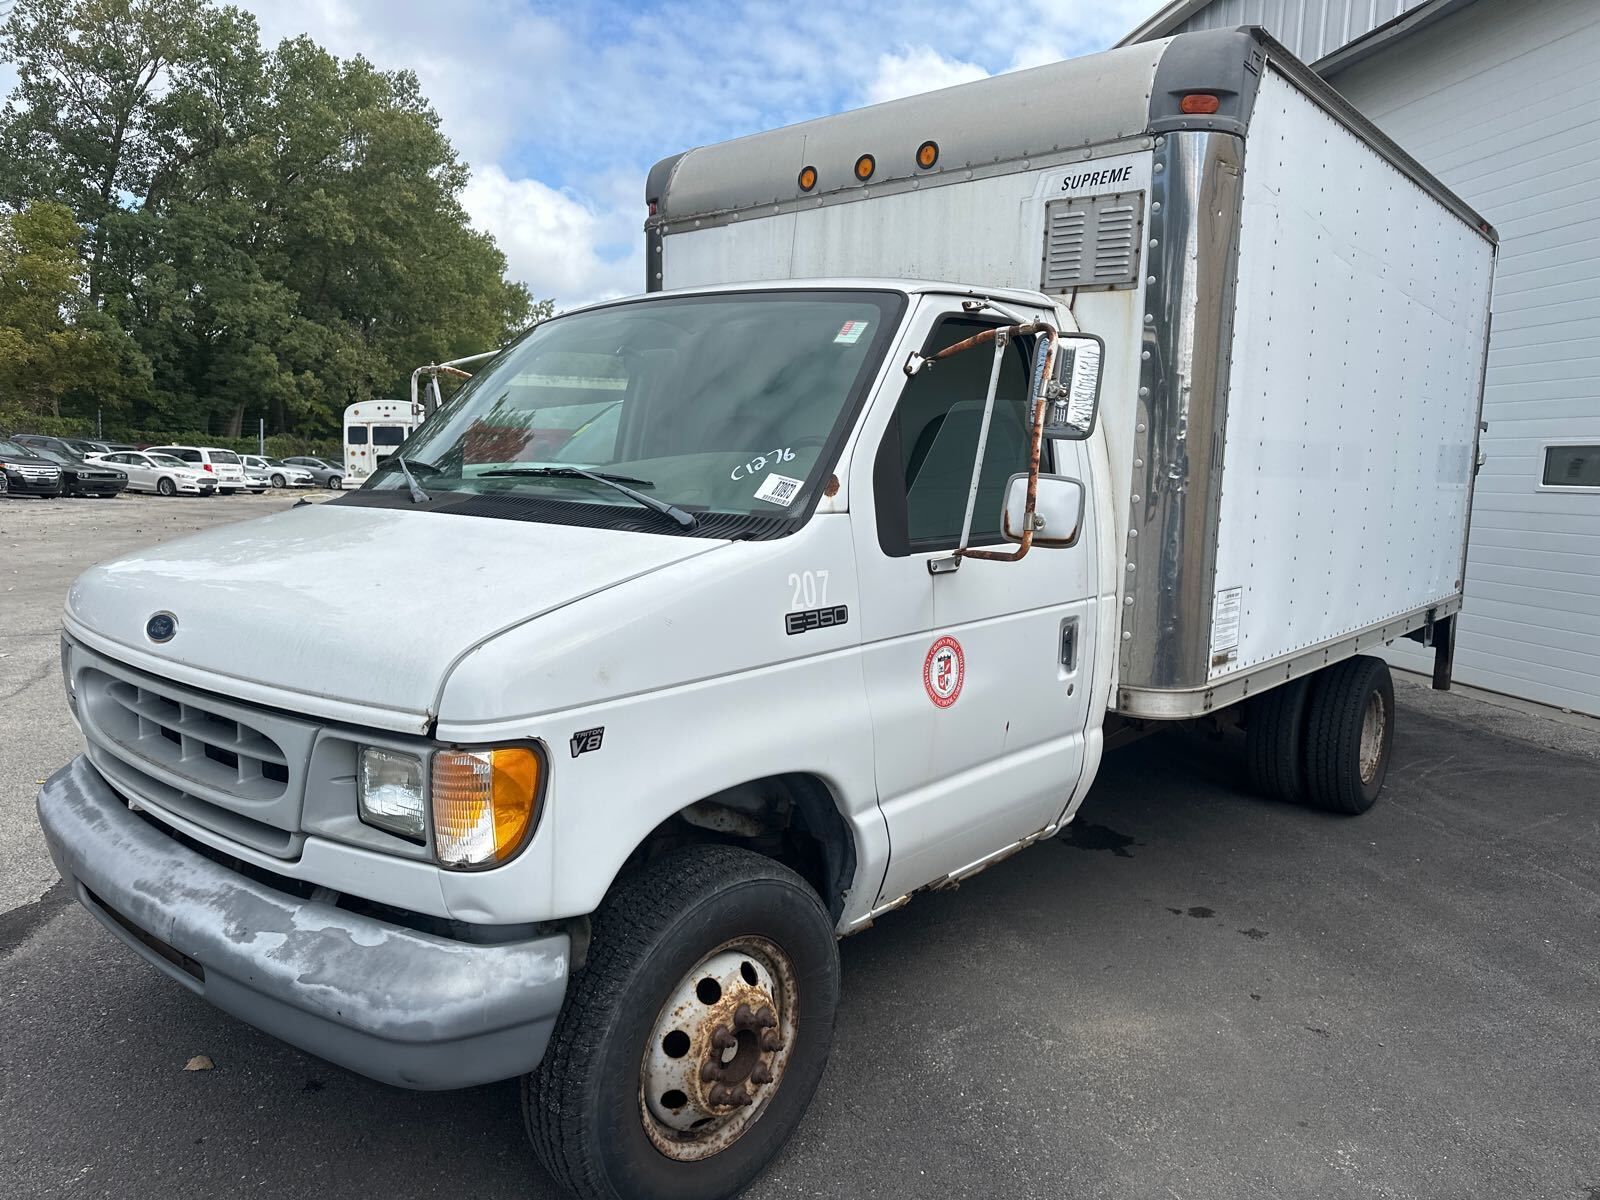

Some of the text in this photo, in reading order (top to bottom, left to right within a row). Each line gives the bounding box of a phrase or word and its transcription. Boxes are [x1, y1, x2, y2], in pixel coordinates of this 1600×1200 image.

[1061, 165, 1133, 191] SUPREME
[730, 447, 797, 481] C1276
[788, 570, 829, 611] 207
[571, 735, 602, 757] V8
[575, 728, 604, 739] TRITON
